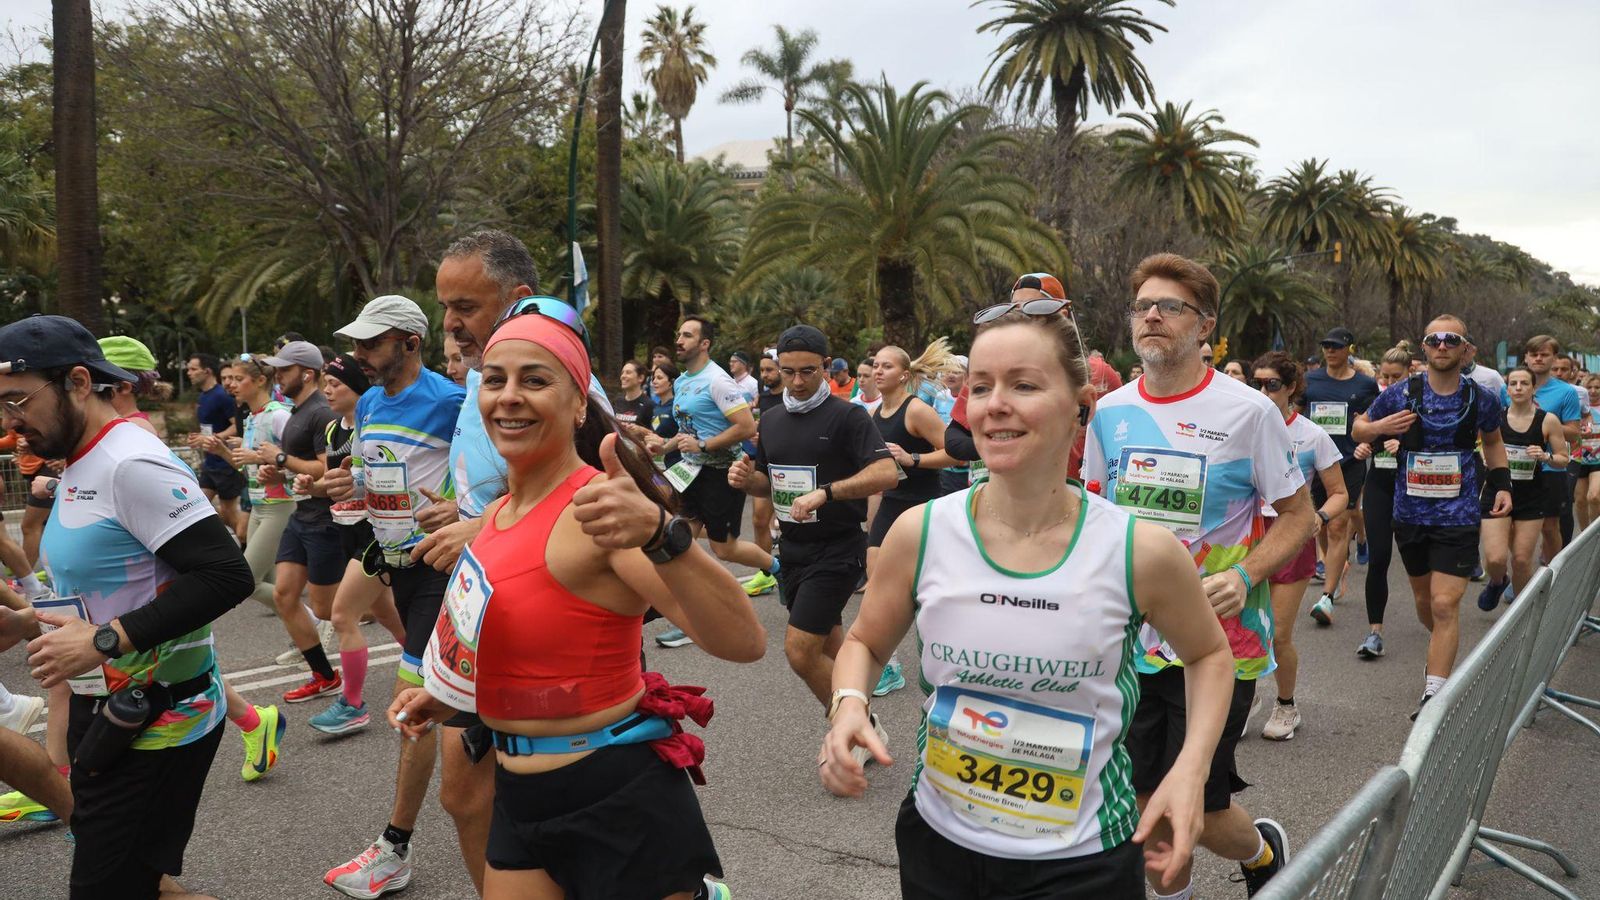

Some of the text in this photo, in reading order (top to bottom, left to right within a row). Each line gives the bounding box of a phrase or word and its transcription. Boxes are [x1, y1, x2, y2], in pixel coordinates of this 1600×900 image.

[1317, 416, 1340, 425] 4739
[1420, 474, 1451, 485] 6658
[1128, 485, 1187, 511] 4749
[930, 642, 1106, 679] CRAUGHWELL
[956, 669, 1081, 694] Athletic Club
[956, 729, 1005, 750] TotalEnergies
[1013, 739, 1064, 754] 1/2 MARATÓN
[1011, 747, 1056, 761] DE MÁLAGA
[956, 754, 1056, 803] 3429
[967, 788, 1025, 811] Susanne Breen
